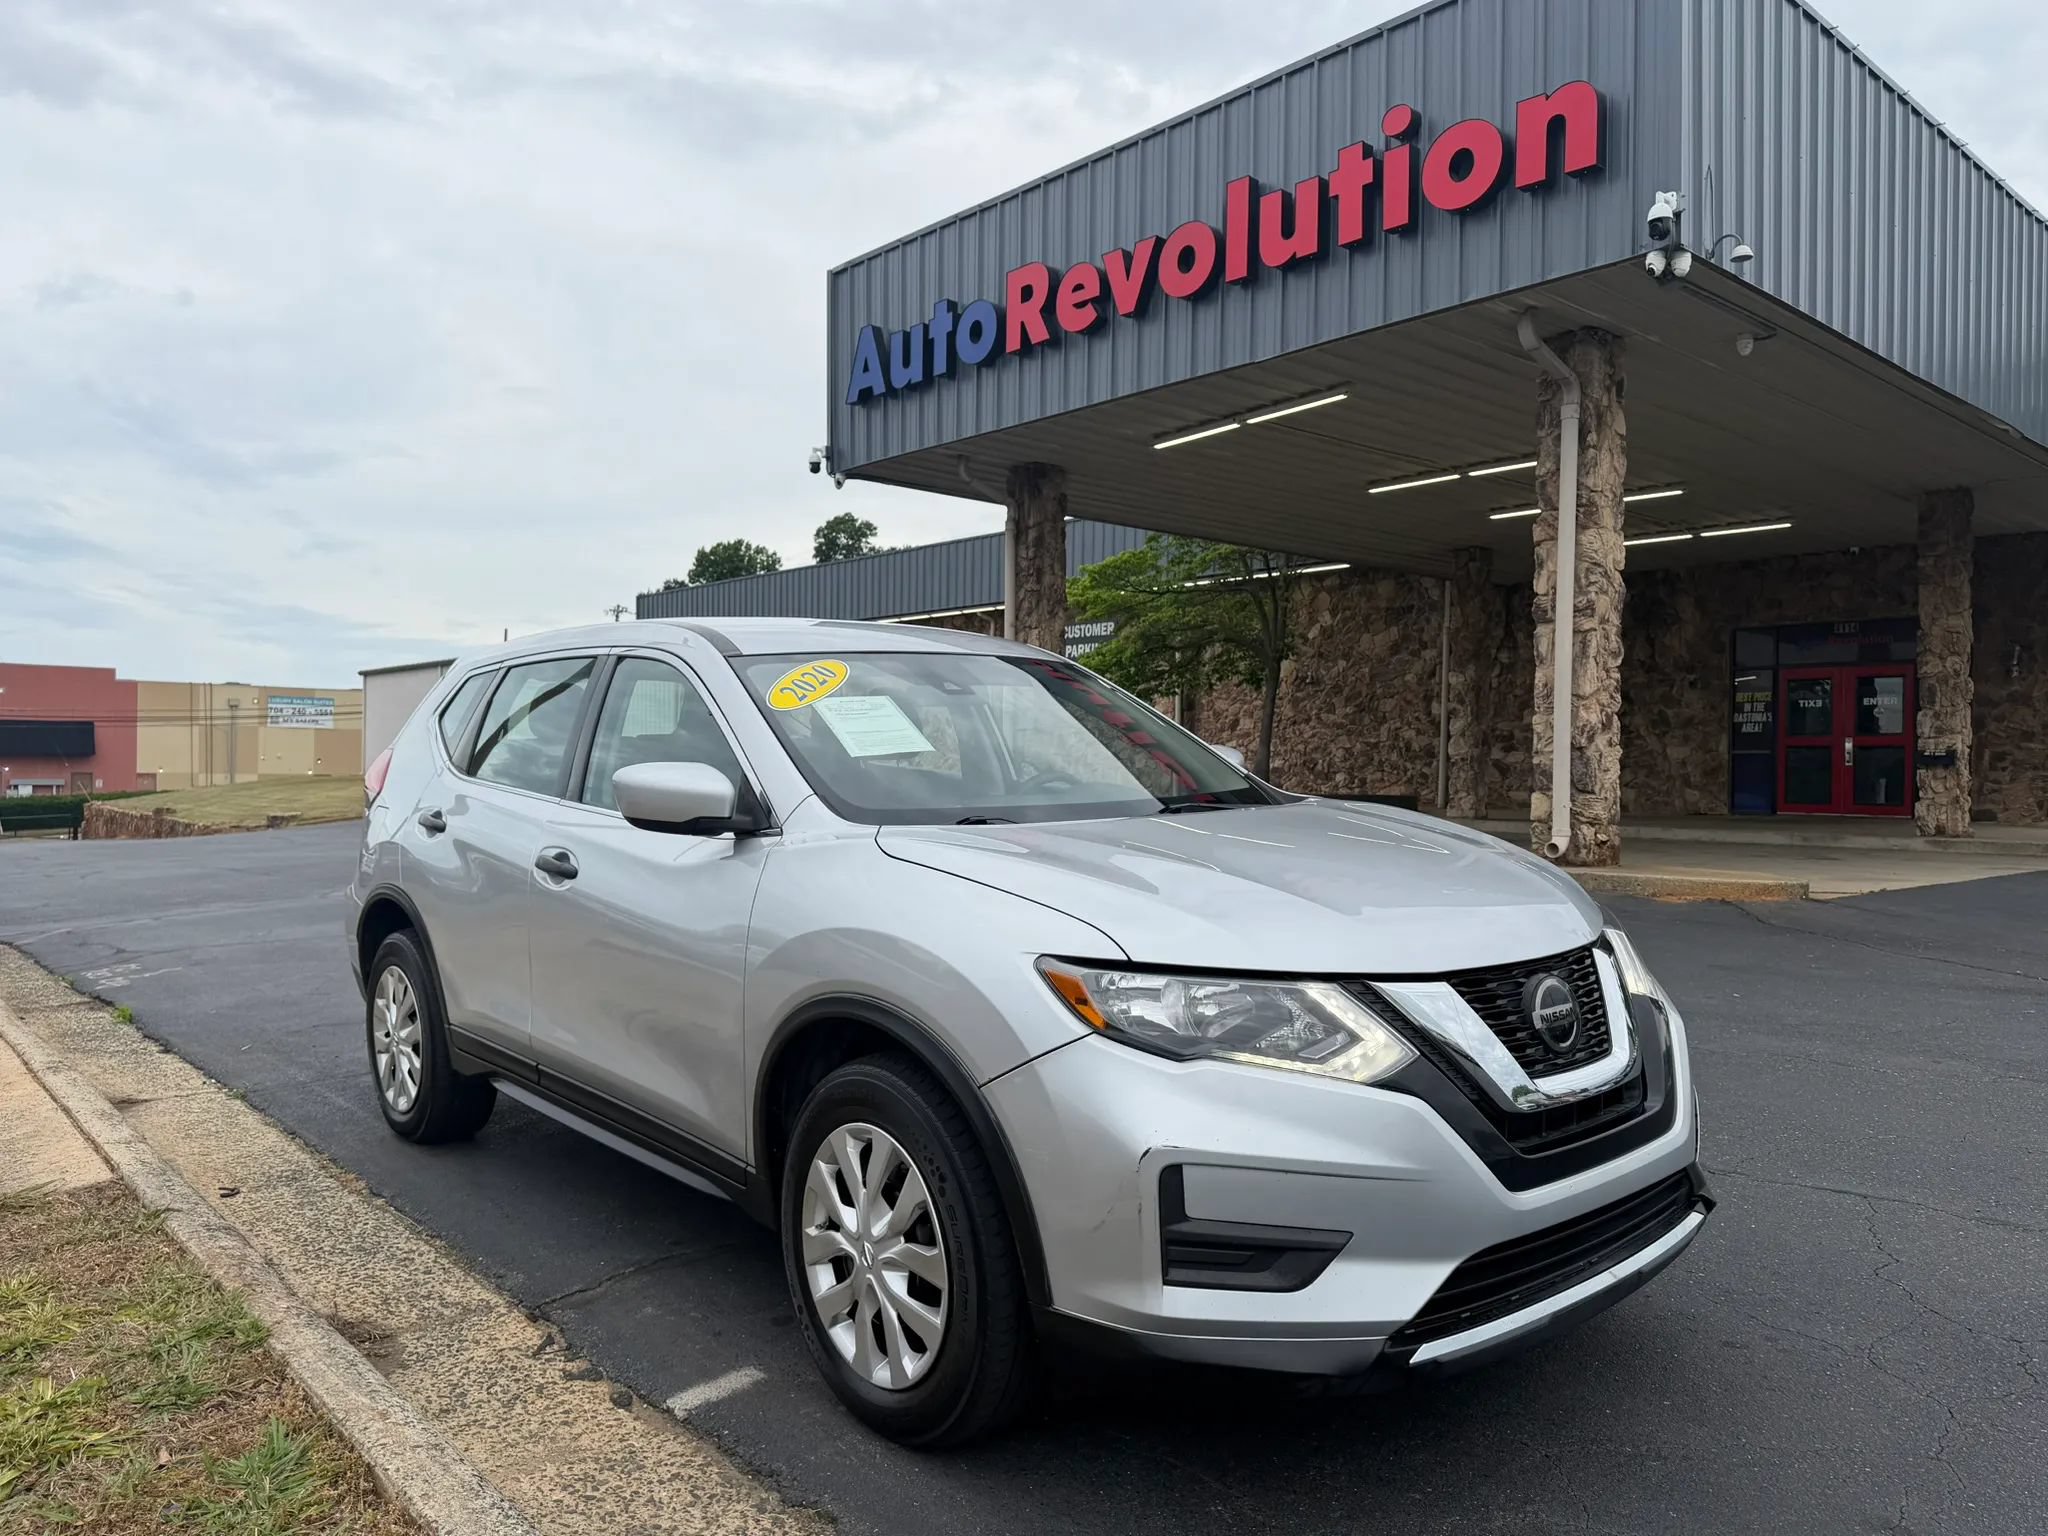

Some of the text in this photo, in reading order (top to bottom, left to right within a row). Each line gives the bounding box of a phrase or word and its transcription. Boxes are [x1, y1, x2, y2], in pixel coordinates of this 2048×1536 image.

[780, 665, 836, 701] 2020
[1753, 702, 1766, 712] THE
[1863, 696, 1898, 706] ENTER
[1540, 1007, 1574, 1024] NISSAN
